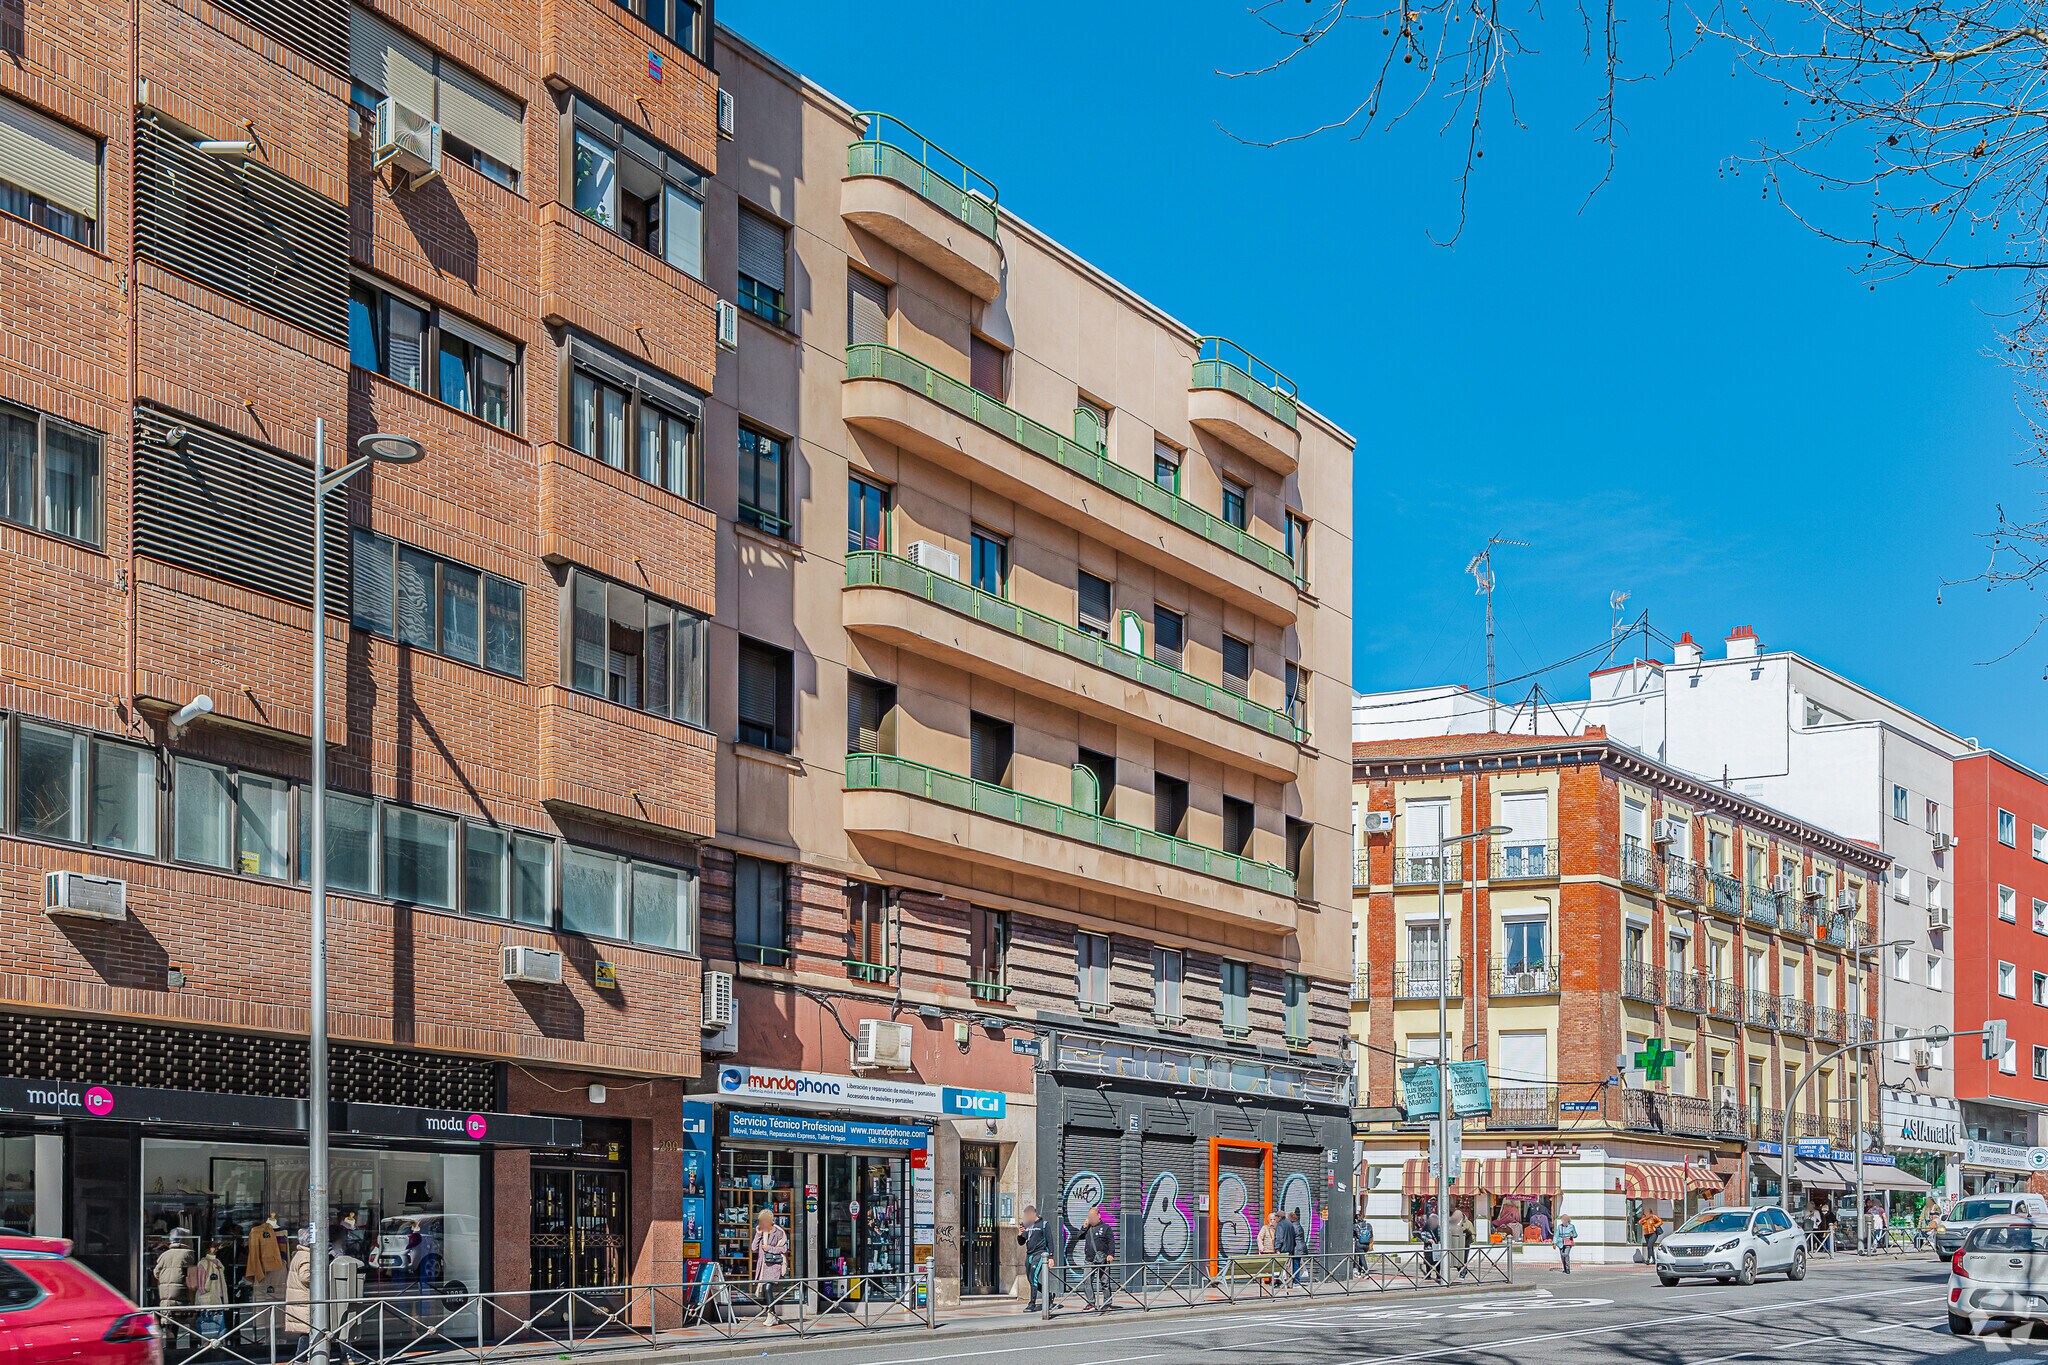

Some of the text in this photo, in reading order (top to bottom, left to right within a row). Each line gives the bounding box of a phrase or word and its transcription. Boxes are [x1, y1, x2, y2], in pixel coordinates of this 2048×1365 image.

[747, 1075, 840, 1096] mundophone
[1405, 1079, 1434, 1088] Presenta
[1453, 1076, 1474, 1084] Juntos
[1454, 1081, 1487, 1091] mejoramos
[846, 1082, 869, 1092] Liberación
[871, 1086, 894, 1095] reparación
[898, 1088, 914, 1097] móviles
[917, 1090, 937, 1098] portátiles
[1406, 1087, 1417, 1095] tus
[1407, 1091, 1438, 1101] en Decide
[1454, 1088, 1478, 1097] Madrid
[26, 1089, 82, 1107] moda
[846, 1092, 871, 1101] Accesorios
[875, 1095, 892, 1103] móviles
[894, 1096, 914, 1105] portátiles
[955, 1095, 999, 1112] DIGI
[1408, 1098, 1432, 1107] Madrid
[425, 1116, 465, 1132] moda
[733, 1114, 847, 1134] Servicio Técnico Profesional
[732, 1127, 847, 1144] Móvil, Tablets, Reparación Express, Taller Propio
[850, 1127, 926, 1139] www.mundophone.com
[867, 1136, 909, 1147] Tel: 910 856 242
